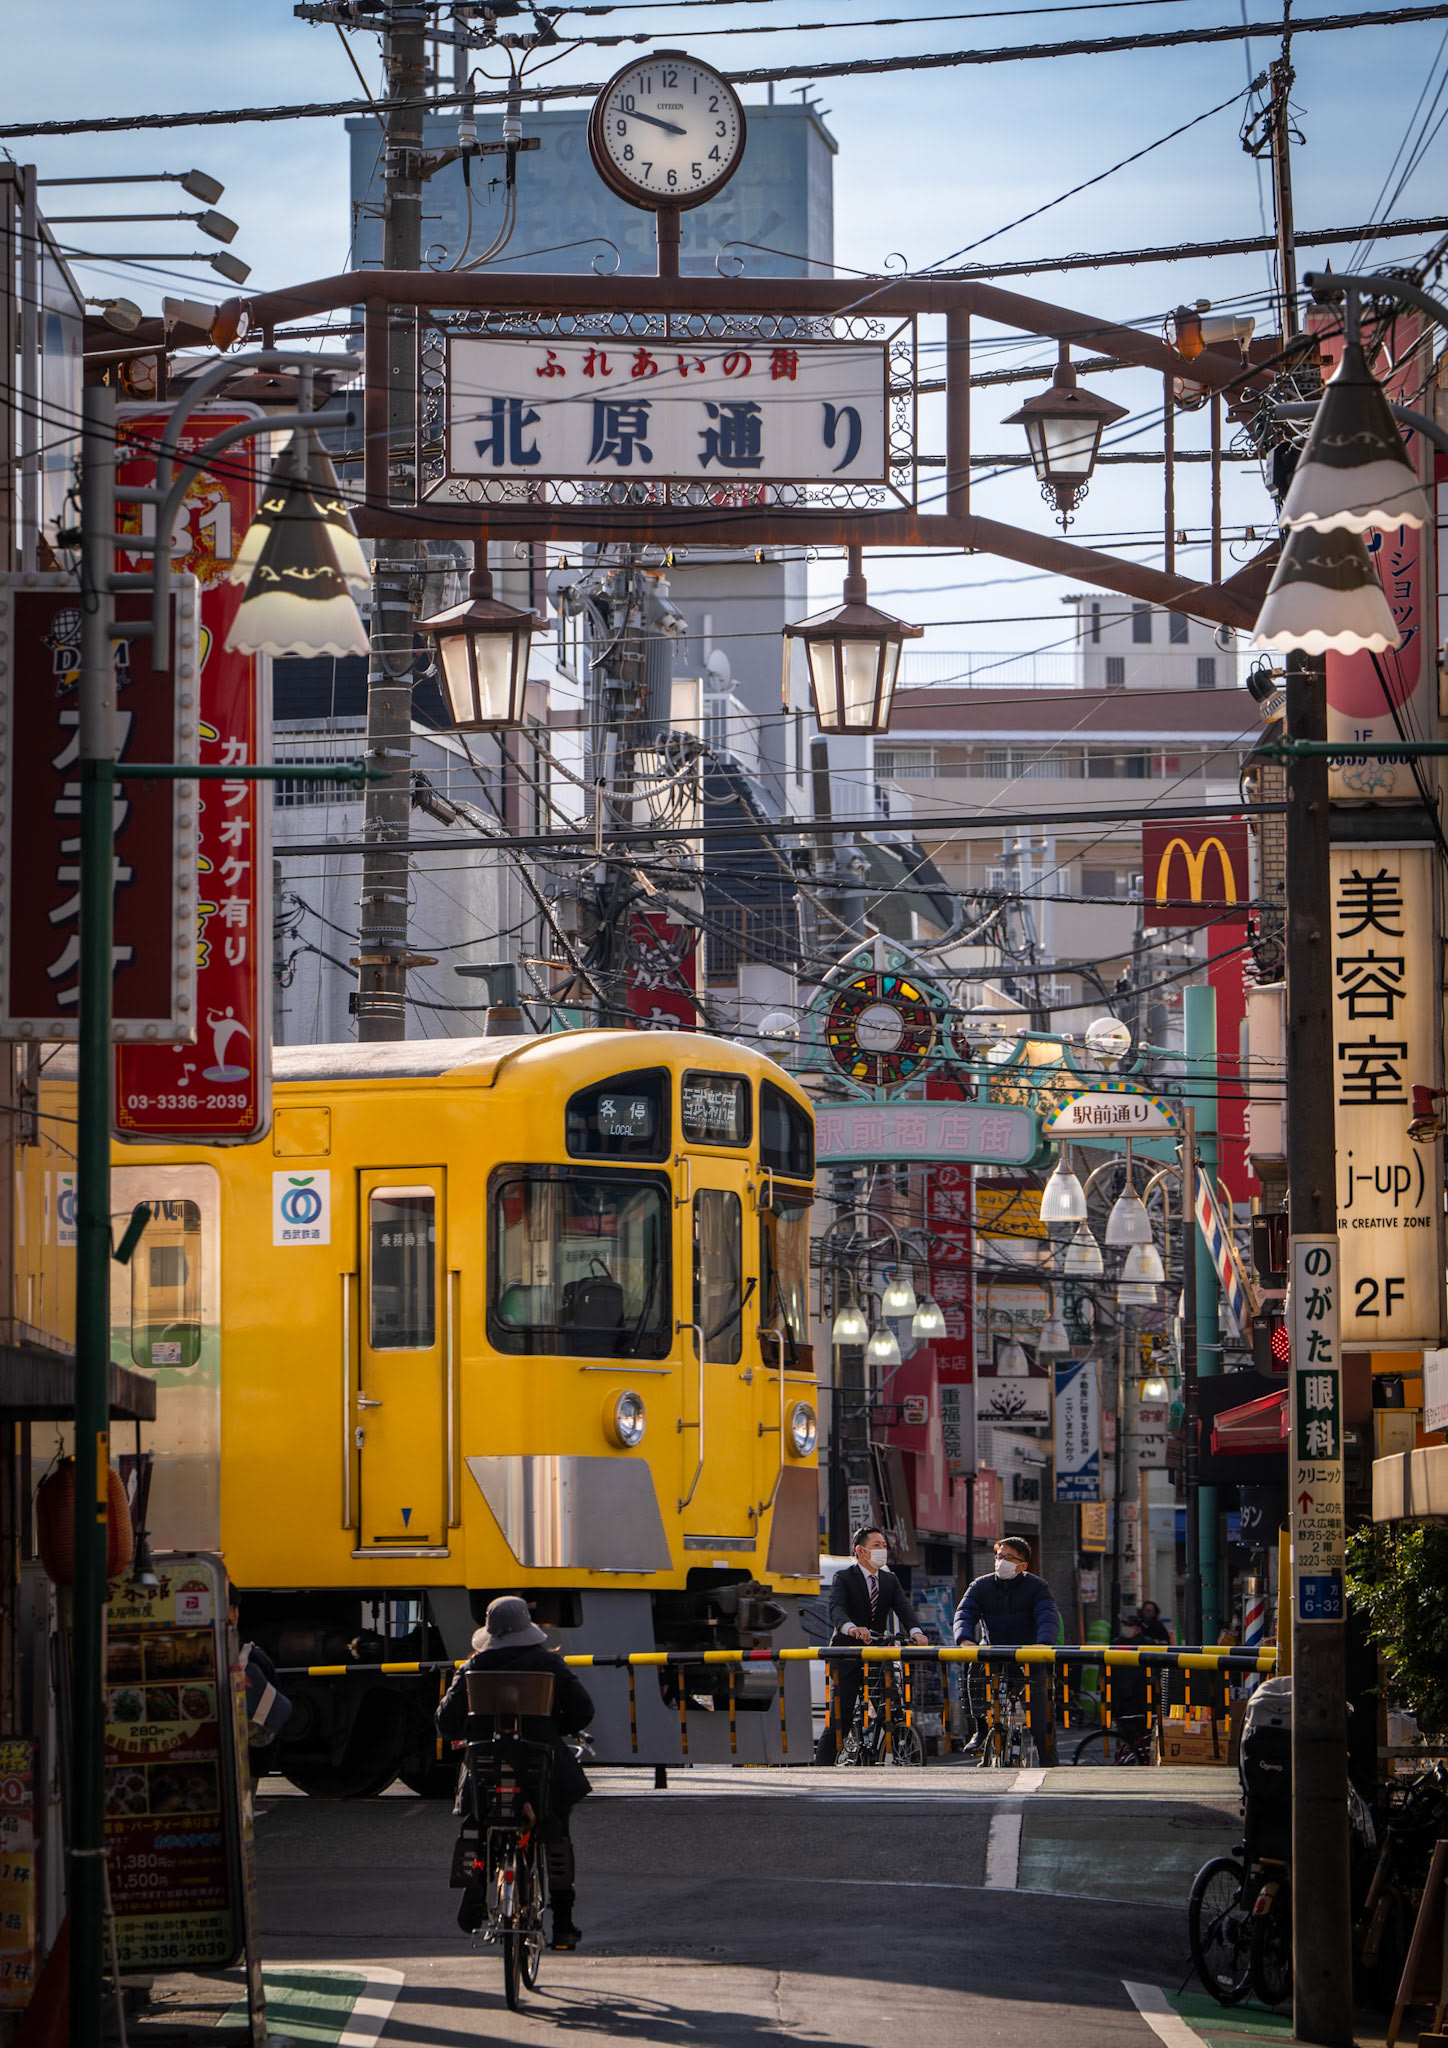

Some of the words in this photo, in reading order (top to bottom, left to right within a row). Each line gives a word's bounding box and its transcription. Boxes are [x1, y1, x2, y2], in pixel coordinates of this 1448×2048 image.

[640, 76, 651, 94] 11
[663, 71, 678, 88] 12
[620, 95, 635, 112] 10
[708, 96, 719, 113] 2
[616, 119, 627, 137] 9
[715, 120, 727, 138] 3
[623, 144, 634, 161] 8
[708, 145, 721, 162] 4
[641, 162, 653, 180] 7
[667, 169, 677, 186] 6
[691, 163, 702, 180] 5
[536, 348, 800, 381] ふれあいの街
[474, 398, 865, 473] 北原通り
[1354, 729, 1374, 742] 1F
[219, 736, 251, 966] カラオケ有り
[1336, 868, 1408, 1107] 美容室
[128, 1094, 248, 1110] 03-3336-2039
[600, 1099, 647, 1120] 各停
[1072, 1104, 1149, 1125] 駅前通り
[610, 1124, 635, 1136] LOCAL
[815, 1112, 1014, 1154] 駅前商店街
[1351, 1217, 1399, 1230] CREATIVE
[1403, 1215, 1432, 1229] ZONE
[282, 1229, 321, 1241] 西武鉄道
[380, 1233, 428, 1248] 乗務員室
[1354, 1277, 1406, 1318] 2F
[936, 1355, 967, 1371] 本店
[941, 1388, 961, 1458] 重福医院
[1297, 1467, 1342, 1485] クリニック
[1315, 1502, 1342, 1514] この先
[1298, 1518, 1342, 1529] バス広場前
[1304, 1584, 1339, 1597] 野方
[1304, 1600, 1340, 1612] 6-32
